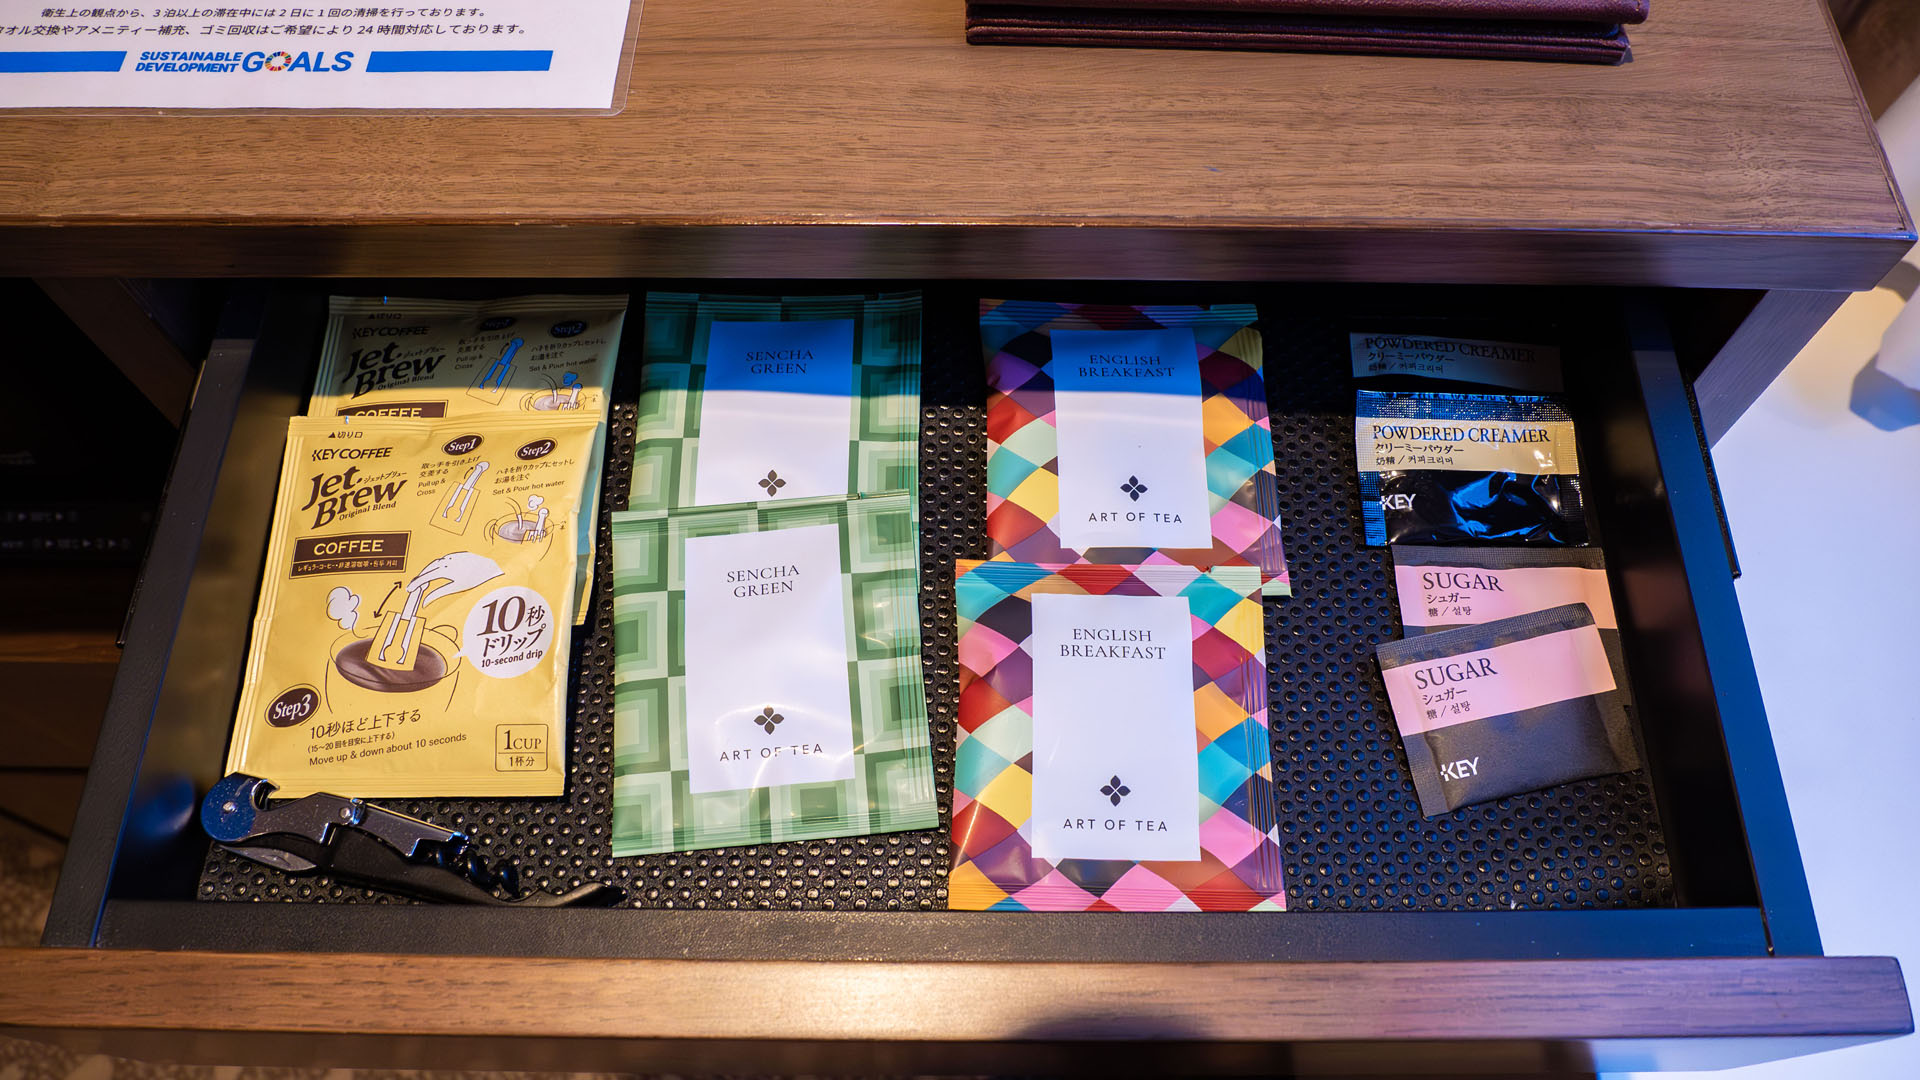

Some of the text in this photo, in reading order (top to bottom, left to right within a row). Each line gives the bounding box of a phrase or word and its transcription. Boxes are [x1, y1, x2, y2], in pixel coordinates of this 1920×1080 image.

[140, 51, 243, 61] SUSTAINABLE
[242, 51, 354, 72] GOALS
[136, 63, 239, 72] DEVELOPMENT
[746, 349, 815, 362] SENCHA
[1364, 337, 1536, 363] POWDERED CREAMER
[342, 341, 399, 384] Jet
[1089, 354, 1161, 366] ENGLISH
[351, 355, 446, 399] Brew
[751, 363, 807, 375] GREEN
[1078, 366, 1175, 378] BREAKFAST
[1372, 425, 1551, 443] POWDERED CREAMER
[448, 438, 477, 452] Step1
[521, 441, 551, 456] Step2
[1376, 443, 1465, 454] クリーミーパウダー
[301, 466, 360, 511] Jet
[545, 480, 565, 488] water
[310, 480, 408, 530] Brew
[339, 501, 396, 521] Original Blend
[1379, 494, 1416, 511] KEY
[1089, 512, 1182, 524] ART OF TEA
[313, 539, 384, 555] COFFEE
[726, 564, 800, 583] SENCHA
[1422, 572, 1504, 592] SUGAR
[733, 581, 794, 598] GREEN
[1426, 593, 1471, 604] シュガー
[476, 595, 546, 636] 10秒
[1452, 606, 1472, 616] 설탕
[483, 623, 547, 658] ドリップ
[1072, 628, 1152, 643] ENGLISH
[481, 649, 543, 668] 10-second drip
[1060, 645, 1166, 660] BREAKFAST
[1414, 657, 1498, 690] SUGAR
[1423, 687, 1468, 706] シュガー
[273, 693, 312, 720] Step3
[1450, 701, 1472, 715] 설탕
[310, 708, 422, 740] 10秒ほど上下する
[309, 733, 467, 766] Move up & down about 10 seconds
[720, 743, 824, 762] ART OF TEA
[509, 756, 535, 767] 1杯分
[1440, 757, 1480, 783] KEY
[1063, 818, 1168, 832] ART OF TEA
